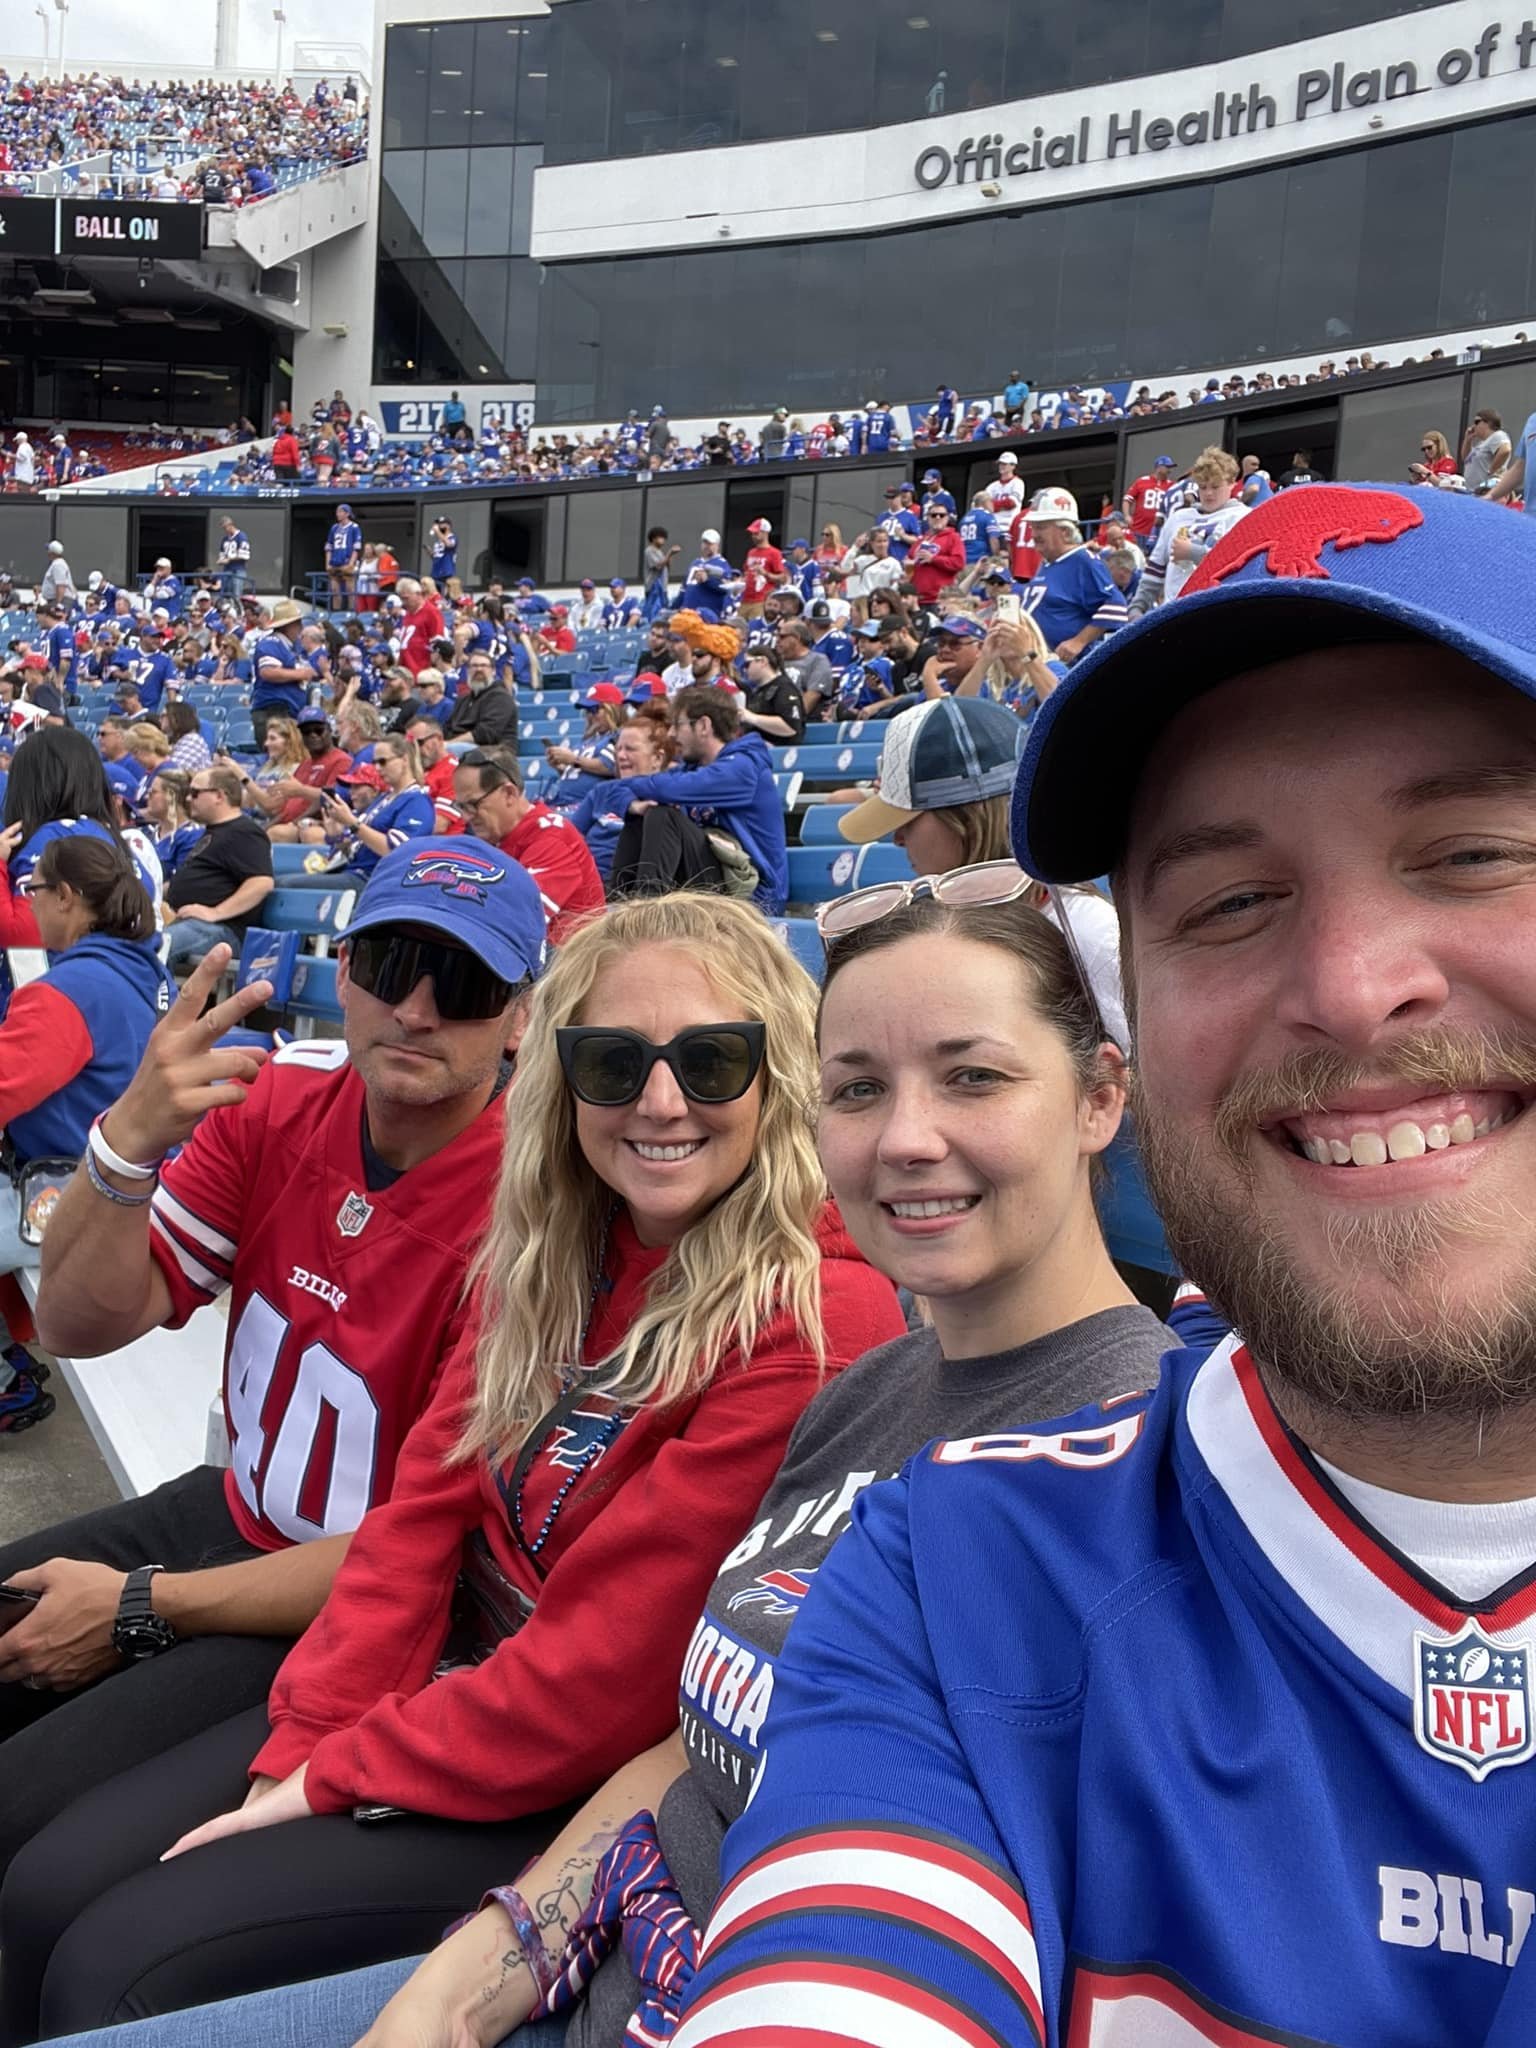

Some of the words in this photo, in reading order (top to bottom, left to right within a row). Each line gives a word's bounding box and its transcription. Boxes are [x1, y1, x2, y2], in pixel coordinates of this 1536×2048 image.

[914, 116, 1089, 190] Official
[1107, 82, 1276, 160] Health
[1295, 61, 1417, 121] Plan
[1436, 22, 1502, 86] of
[205, 174, 221, 187] 27
[75, 215, 126, 239] BALL
[129, 217, 159, 241] ON
[399, 402, 447, 433] 217
[482, 402, 536, 433] 218
[870, 420, 884, 434] 17
[334, 533, 347, 549] 21
[1020, 586, 1047, 615] 17
[128, 660, 154, 685] 17
[342, 1207, 363, 1231] NFL
[287, 1265, 348, 1312] BILLS
[228, 1288, 378, 1545] 40
[717, 1470, 877, 1578] BUF
[1432, 1687, 1522, 1756] NFL
[680, 1705, 755, 1786] ILLIEV
